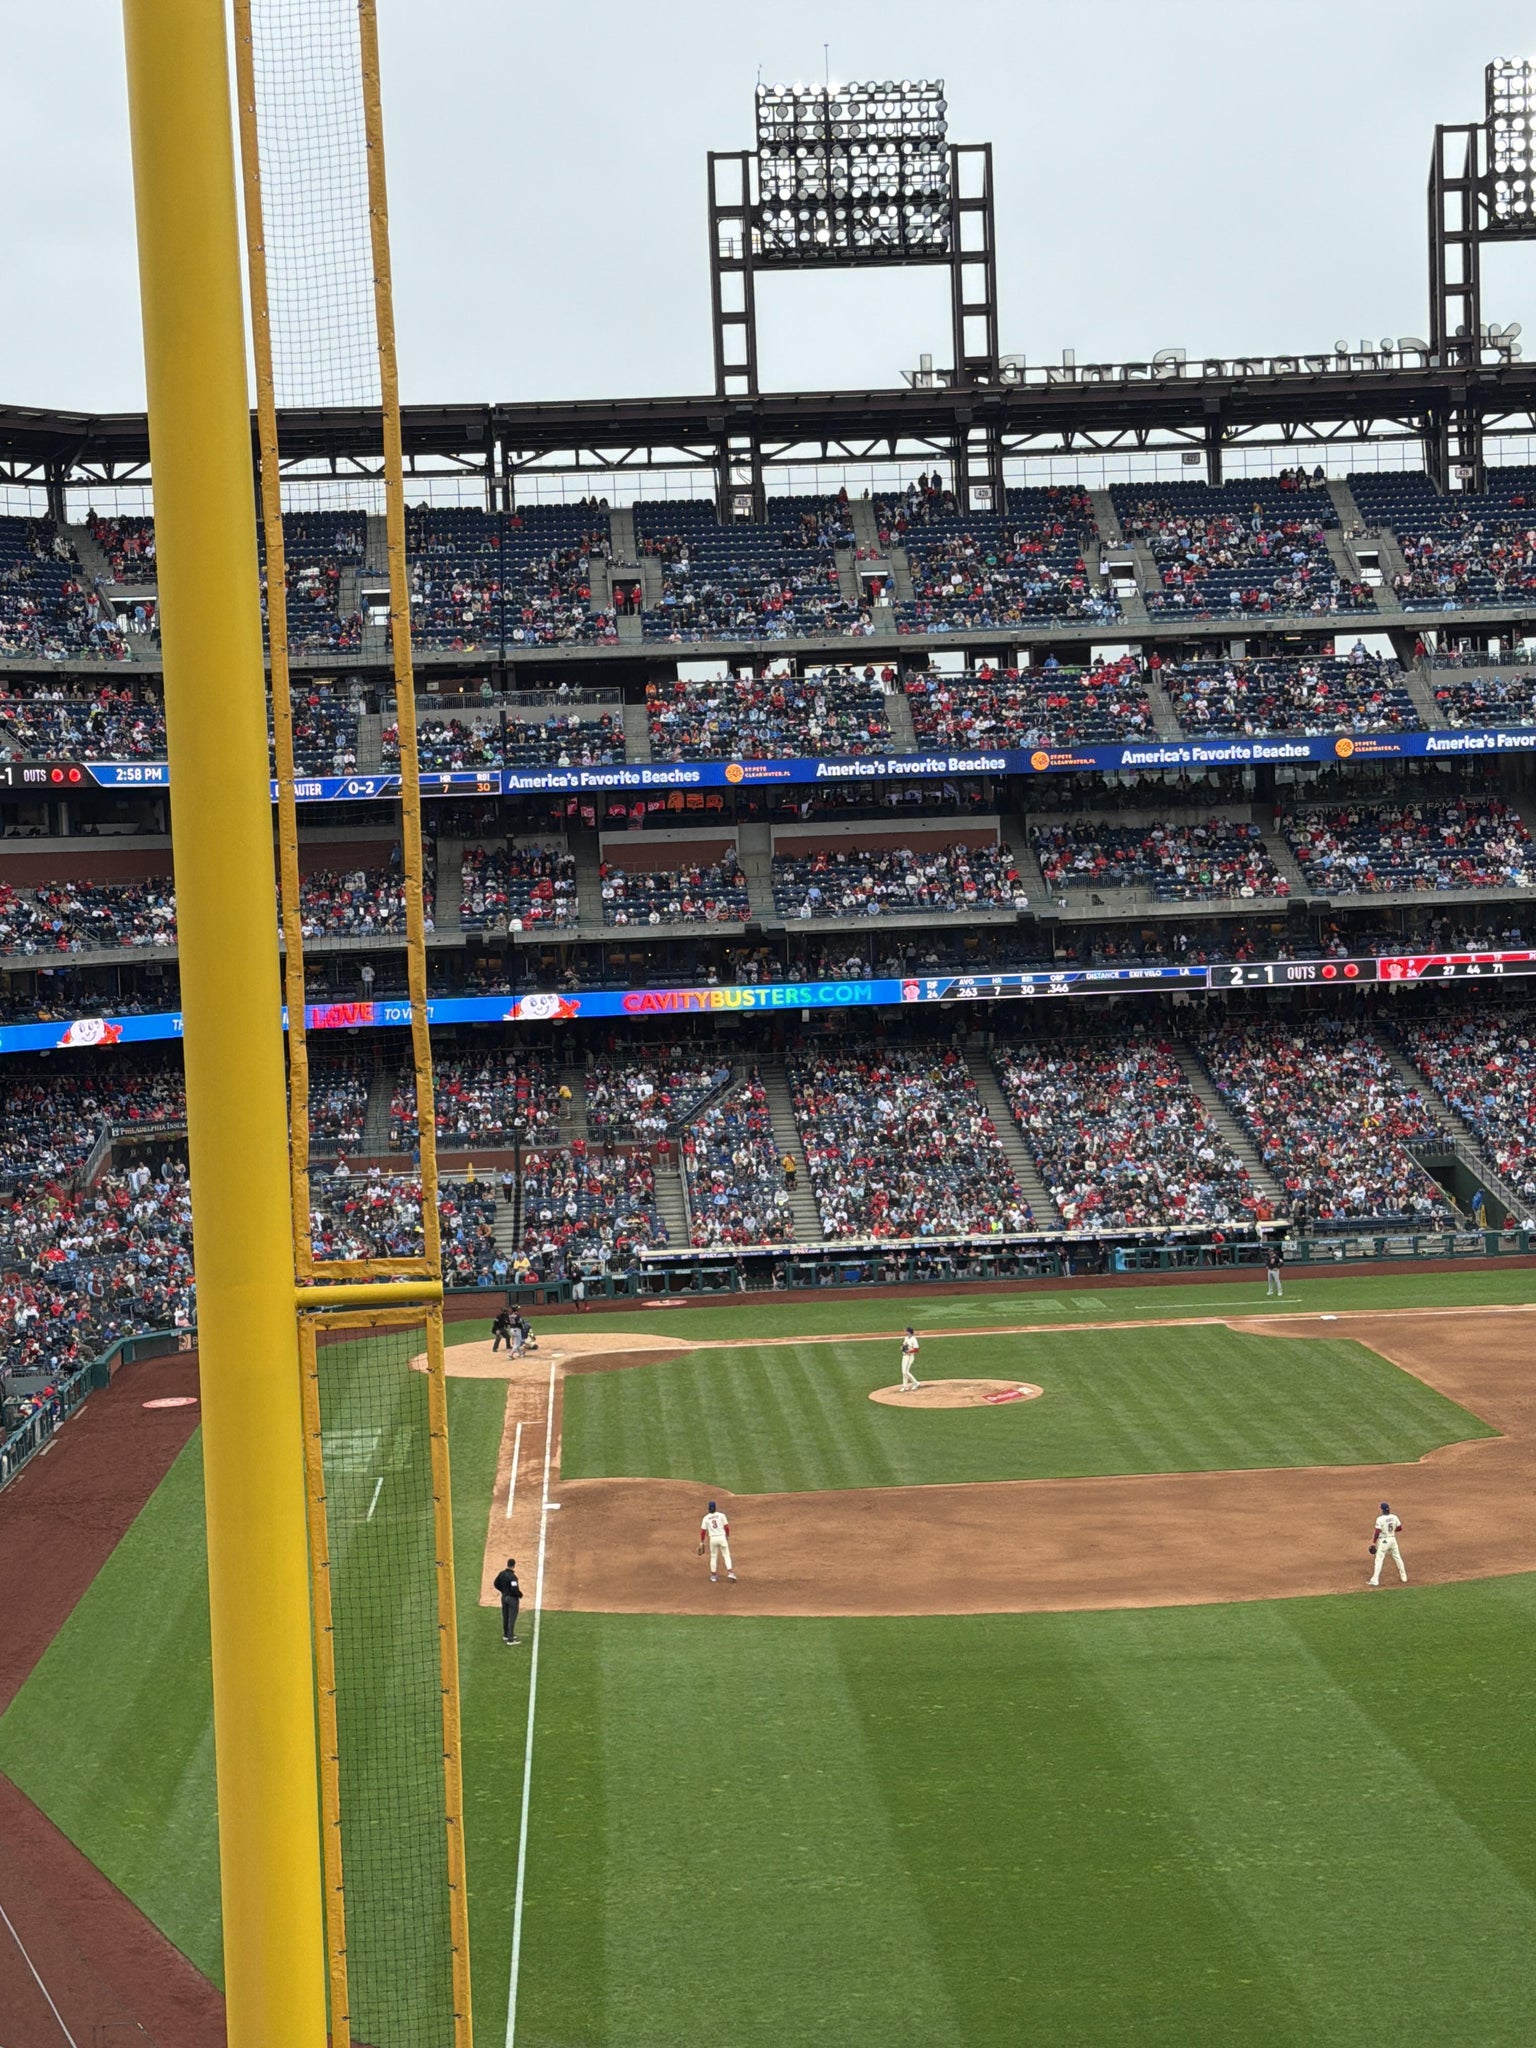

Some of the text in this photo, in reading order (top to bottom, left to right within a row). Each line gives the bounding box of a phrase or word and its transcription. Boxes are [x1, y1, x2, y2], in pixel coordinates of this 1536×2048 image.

[1426, 734, 1495, 750] America's
[1121, 743, 1310, 764] America's Favorite Beaches
[816, 757, 1006, 776] America's Favorite Beaches
[23, 769, 46, 782] OUTS
[116, 768, 162, 781] 2:58 PM
[508, 769, 700, 788] America's Favorite Beaches
[348, 781, 374, 794] 0-2
[442, 783, 490, 794] 7 30
[1296, 805, 1366, 816] CADILLAC
[1369, 804, 1400, 813] HALL
[1406, 802, 1424, 810] OF
[1086, 972, 1120, 980] DISTANCE
[1287, 966, 1316, 980] OUTS
[1442, 964, 1504, 975] 27 44 71
[927, 990, 938, 998] 24
[956, 987, 978, 998] .263
[994, 986, 1000, 996] 7
[1020, 985, 1034, 994] 30
[624, 985, 872, 1012] CAVITYBUSTERS.COM
[312, 1003, 374, 1028] LOVE
[384, 1008, 400, 1020] TO
[712, 1520, 718, 1528] 3
